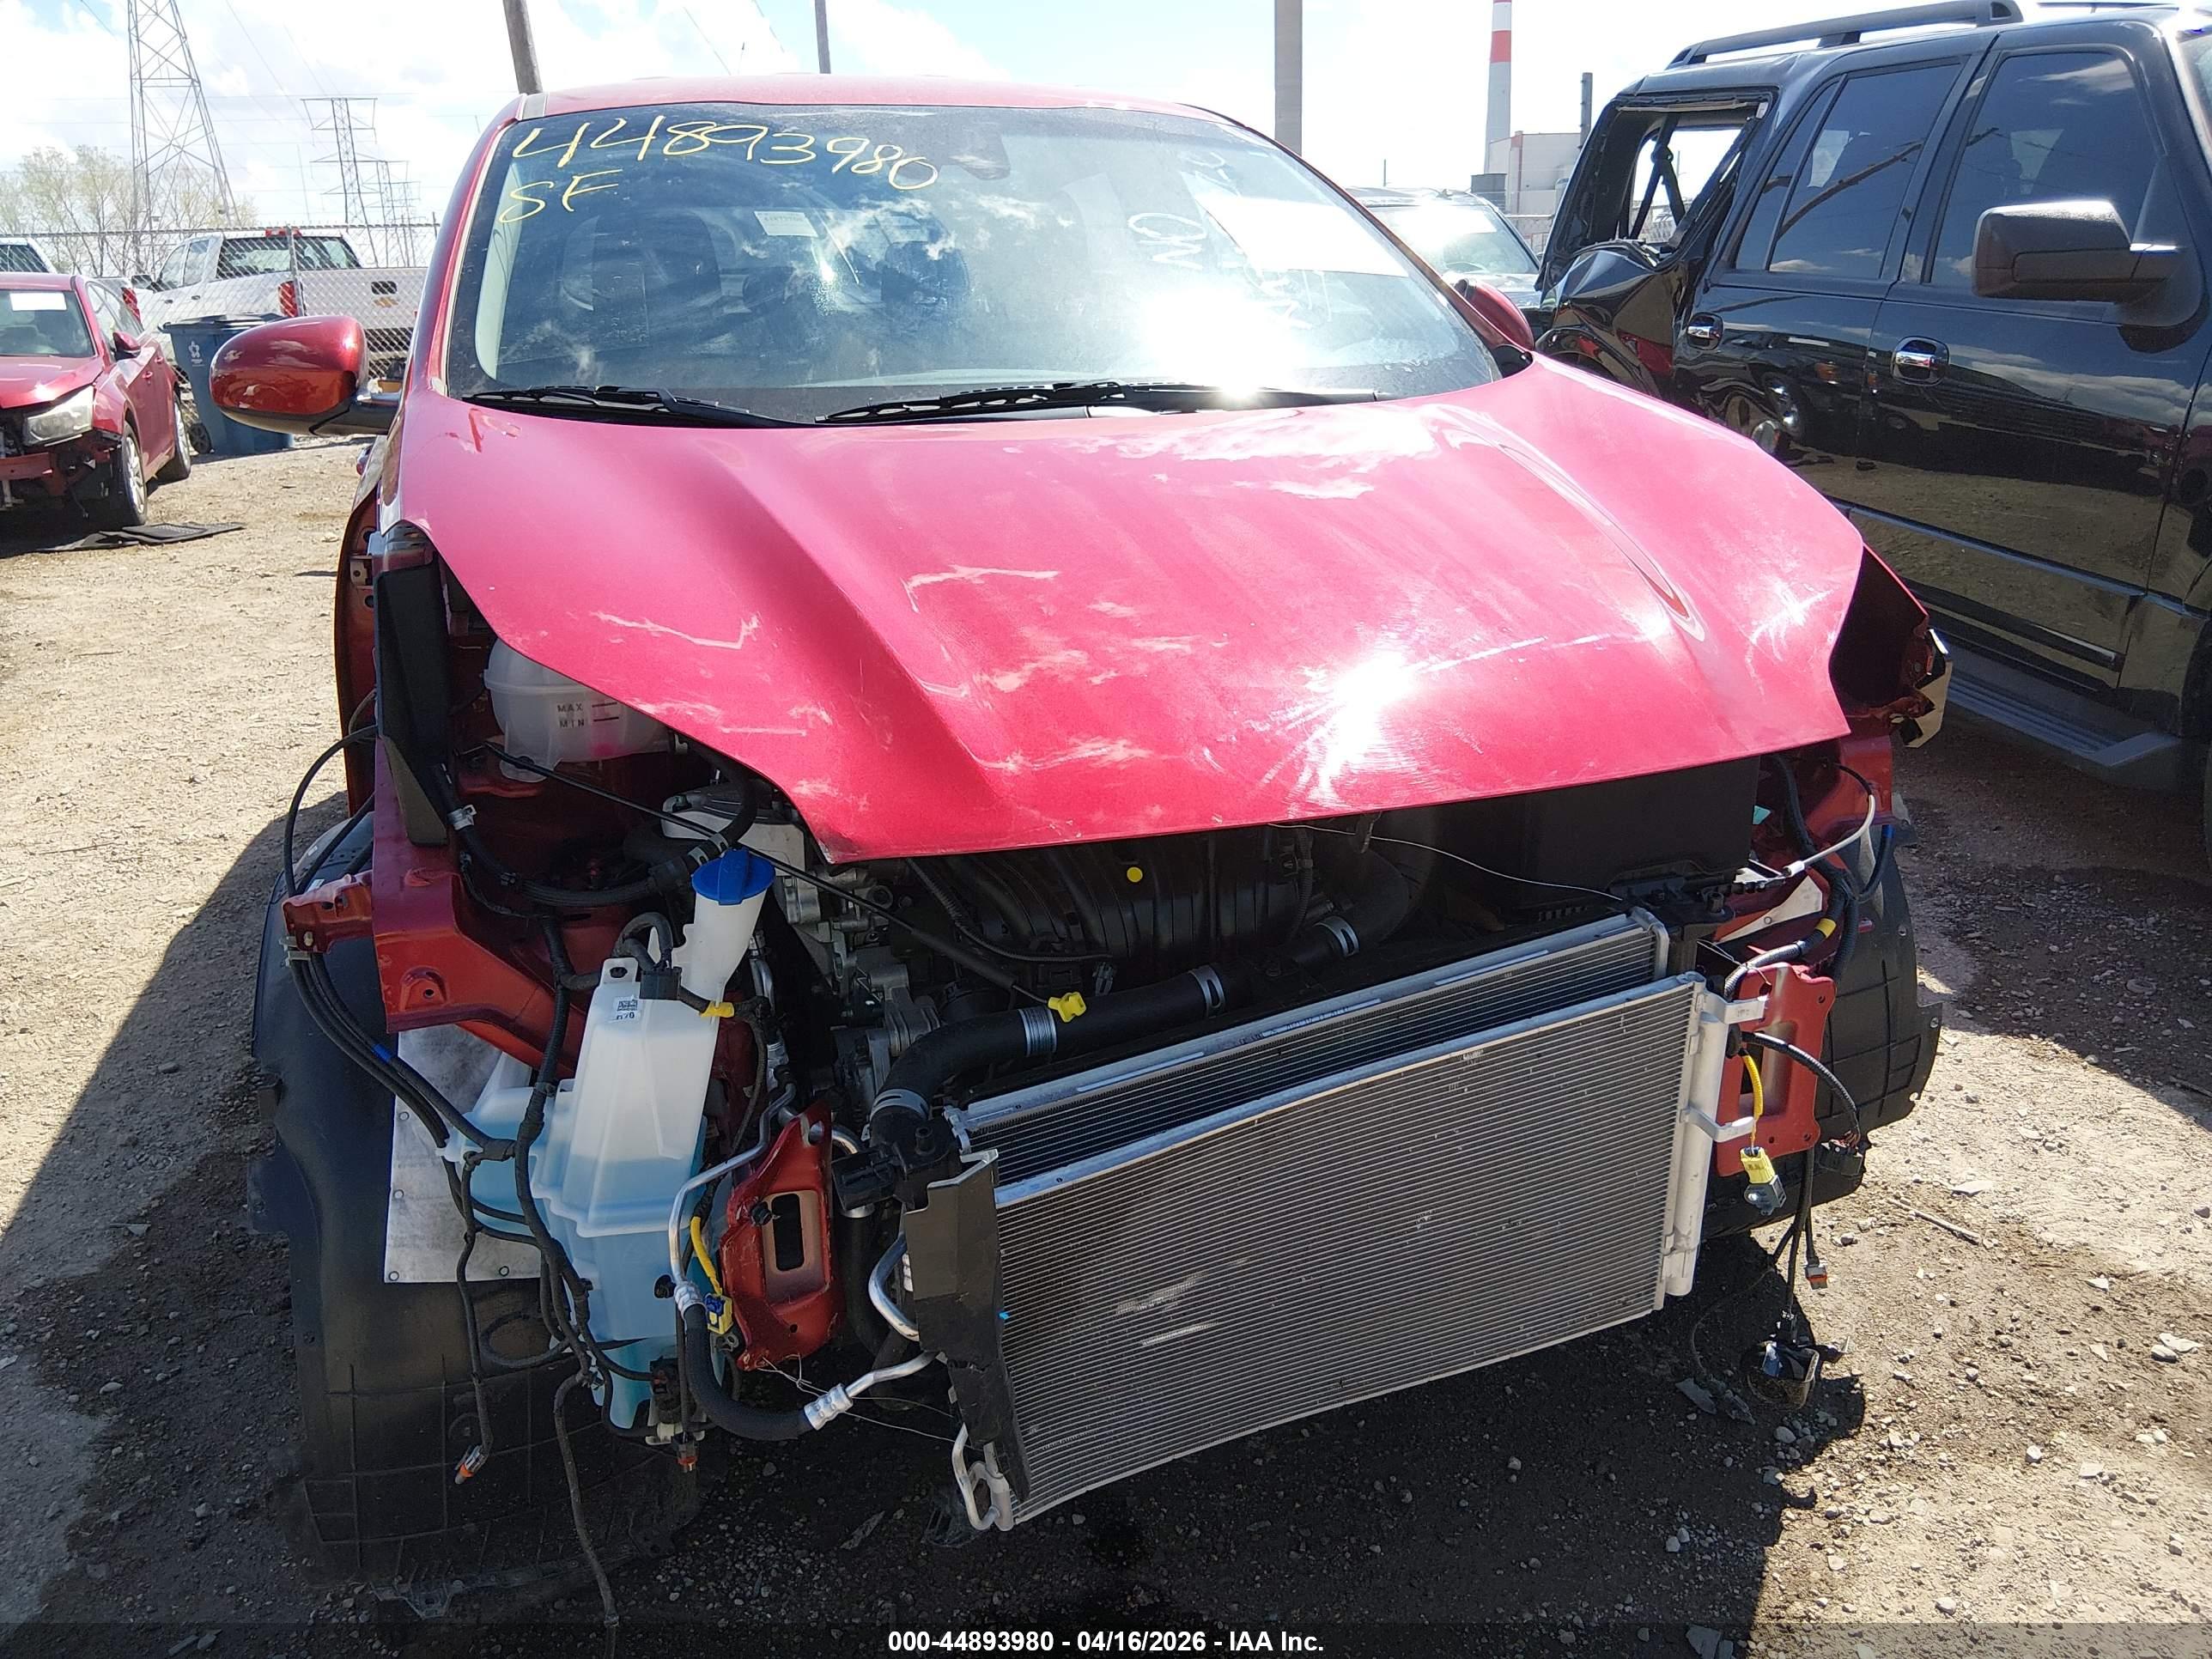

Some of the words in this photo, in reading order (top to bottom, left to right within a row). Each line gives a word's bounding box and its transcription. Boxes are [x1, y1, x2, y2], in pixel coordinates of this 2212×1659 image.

[513, 115, 939, 191] 44893980
[556, 702, 584, 713] MAX
[559, 719, 585, 728] MIN
